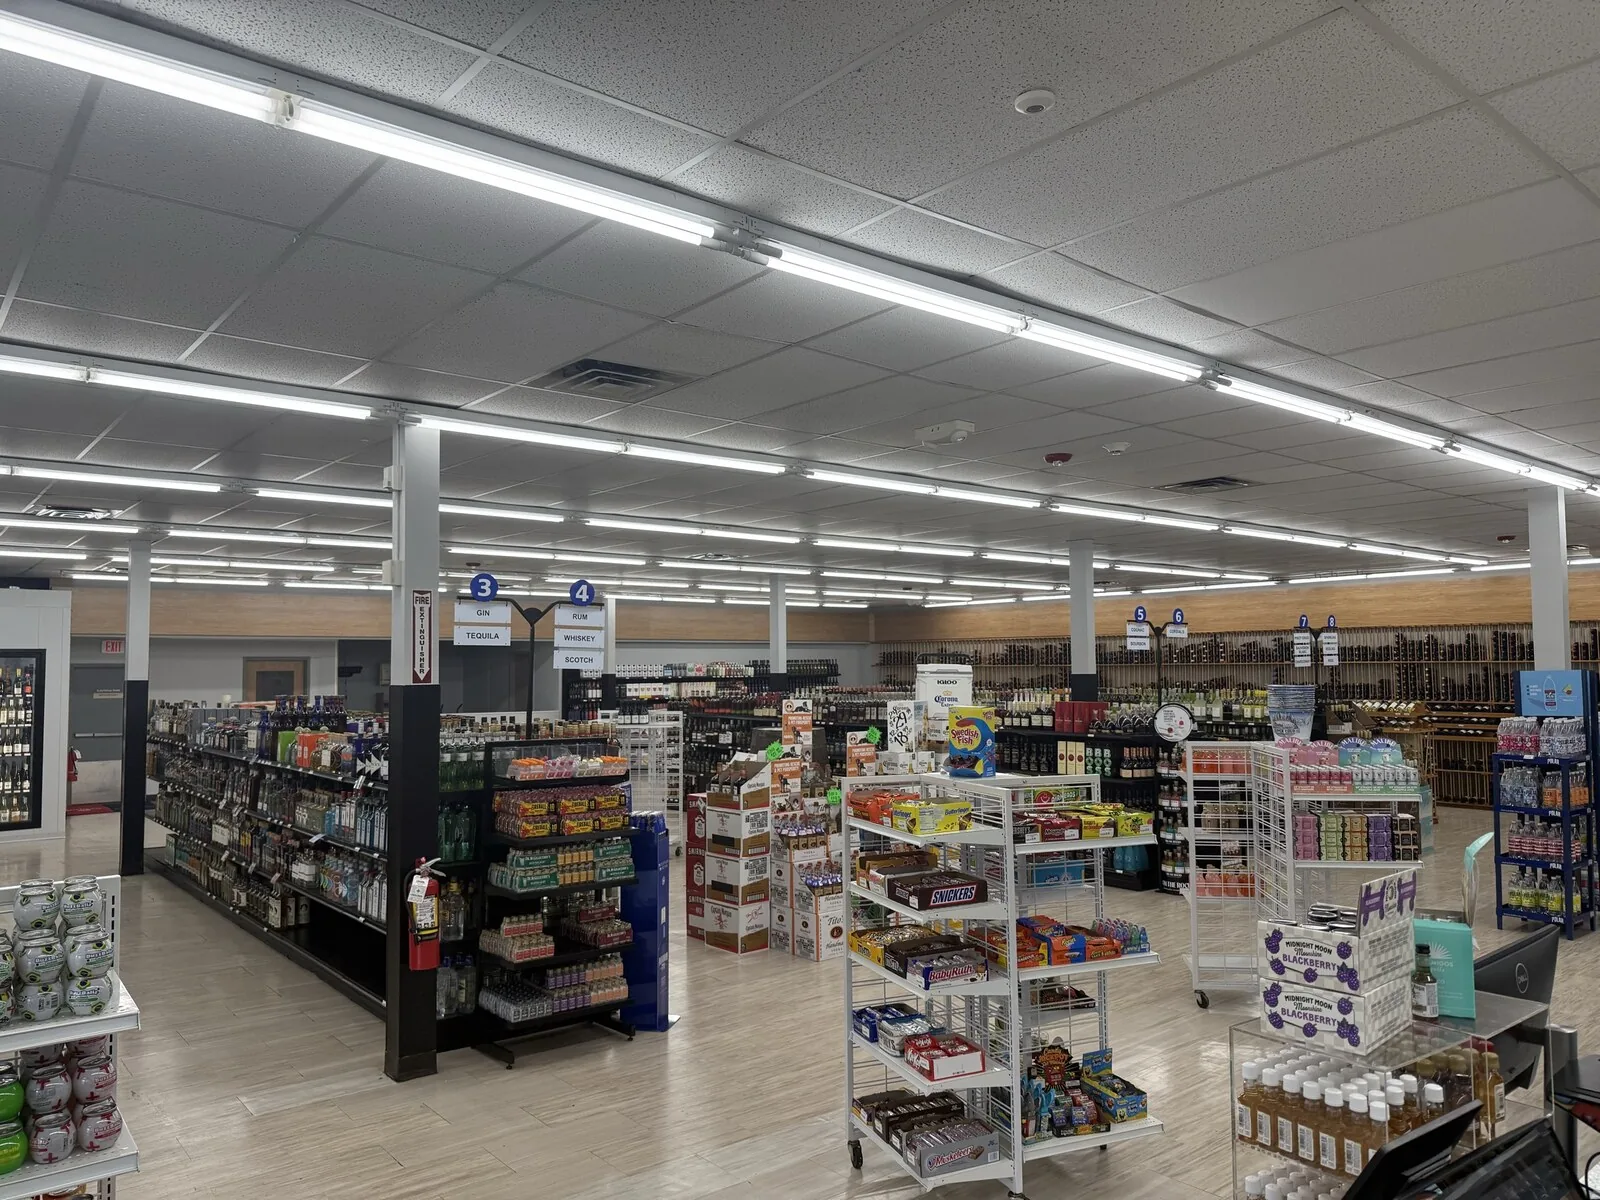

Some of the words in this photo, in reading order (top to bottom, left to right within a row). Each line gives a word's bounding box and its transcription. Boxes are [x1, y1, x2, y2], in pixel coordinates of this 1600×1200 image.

[478, 578, 492, 596] 3
[576, 584, 589, 602] 4
[415, 596, 430, 604] FIRE
[1137, 609, 1144, 620] 5
[1176, 611, 1182, 622] 6
[1302, 617, 1306, 627] 7
[1330, 617, 1334, 627] 8
[106, 641, 122, 652] EXIT
[934, 695, 958, 703] Corona
[951, 729, 979, 739] Swedish
[957, 736, 973, 745] Fish
[1279, 737, 1303, 746] MALIBU
[1310, 740, 1334, 750] MALIBU
[1342, 737, 1367, 747] MALIBU
[1370, 737, 1396, 747] MALIBU
[688, 848, 705, 856] SMIRNO
[932, 887, 975, 904] SNICKERS
[828, 916, 843, 925] Tito'
[826, 941, 843, 949] Handma
[1286, 941, 1313, 952] MIDNIGHT
[1315, 945, 1332, 955] MOON
[1294, 947, 1322, 957] Moonshine
[1282, 954, 1337, 970] BLACKBERRY
[1518, 976, 1528, 984] DELL
[1284, 995, 1313, 1006] MIDNIGHT
[1314, 999, 1332, 1010] MOON
[1294, 1002, 1322, 1012] Moonshine
[1281, 1008, 1337, 1026] BLACKBERRY
